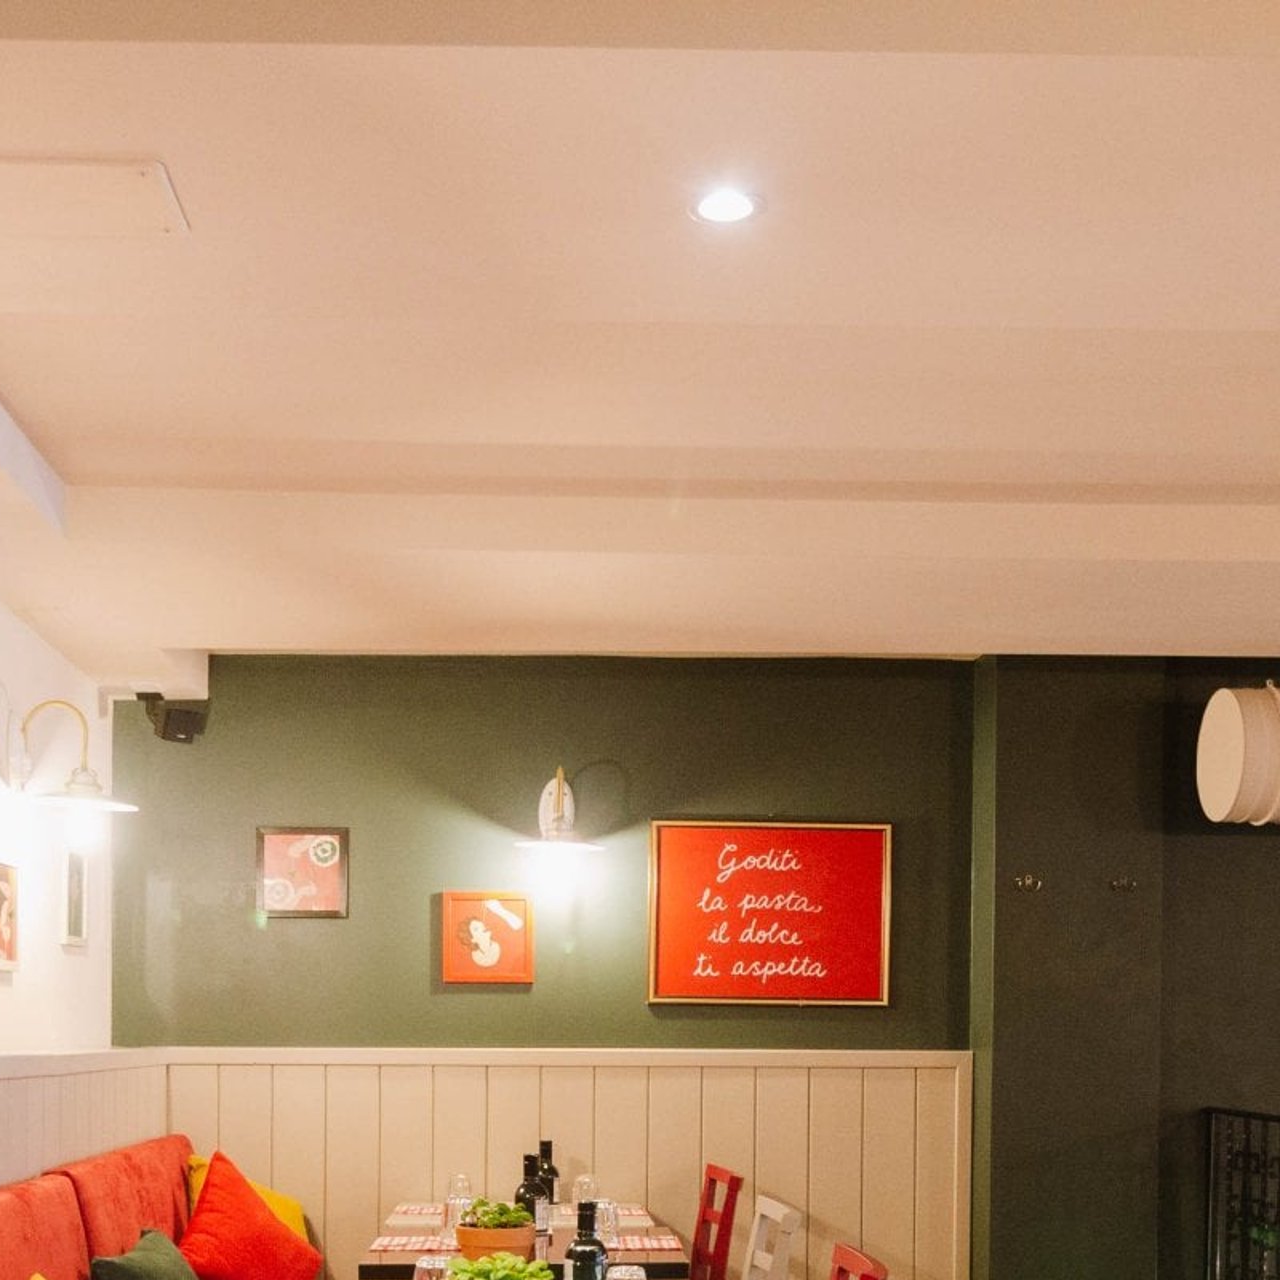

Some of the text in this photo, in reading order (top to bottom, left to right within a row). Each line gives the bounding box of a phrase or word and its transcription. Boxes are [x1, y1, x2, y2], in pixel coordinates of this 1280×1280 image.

[716, 842, 801, 883] Goditi
[697, 887, 823, 919] la pasta,
[707, 917, 804, 946] il dolce
[693, 953, 828, 984] ti aspetta
